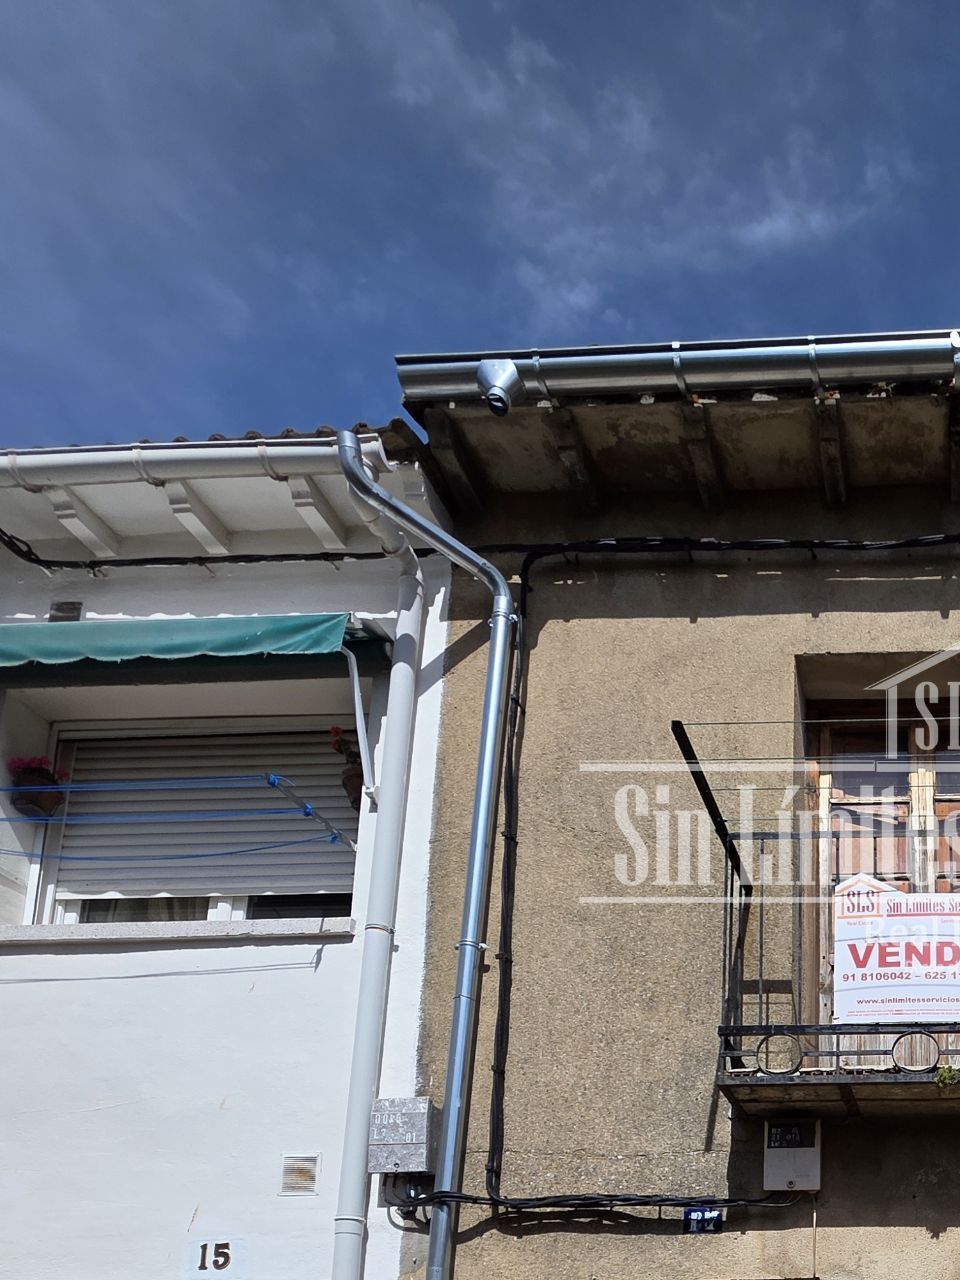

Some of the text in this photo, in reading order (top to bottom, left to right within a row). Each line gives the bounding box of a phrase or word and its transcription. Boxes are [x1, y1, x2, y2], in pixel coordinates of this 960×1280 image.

[847, 890, 876, 913] SLS
[887, 898, 902, 914] Sin
[842, 973, 856, 982] 91
[861, 972, 912, 981] 8106042
[924, 971, 947, 980] 625
[198, 1242, 231, 1271] 15
